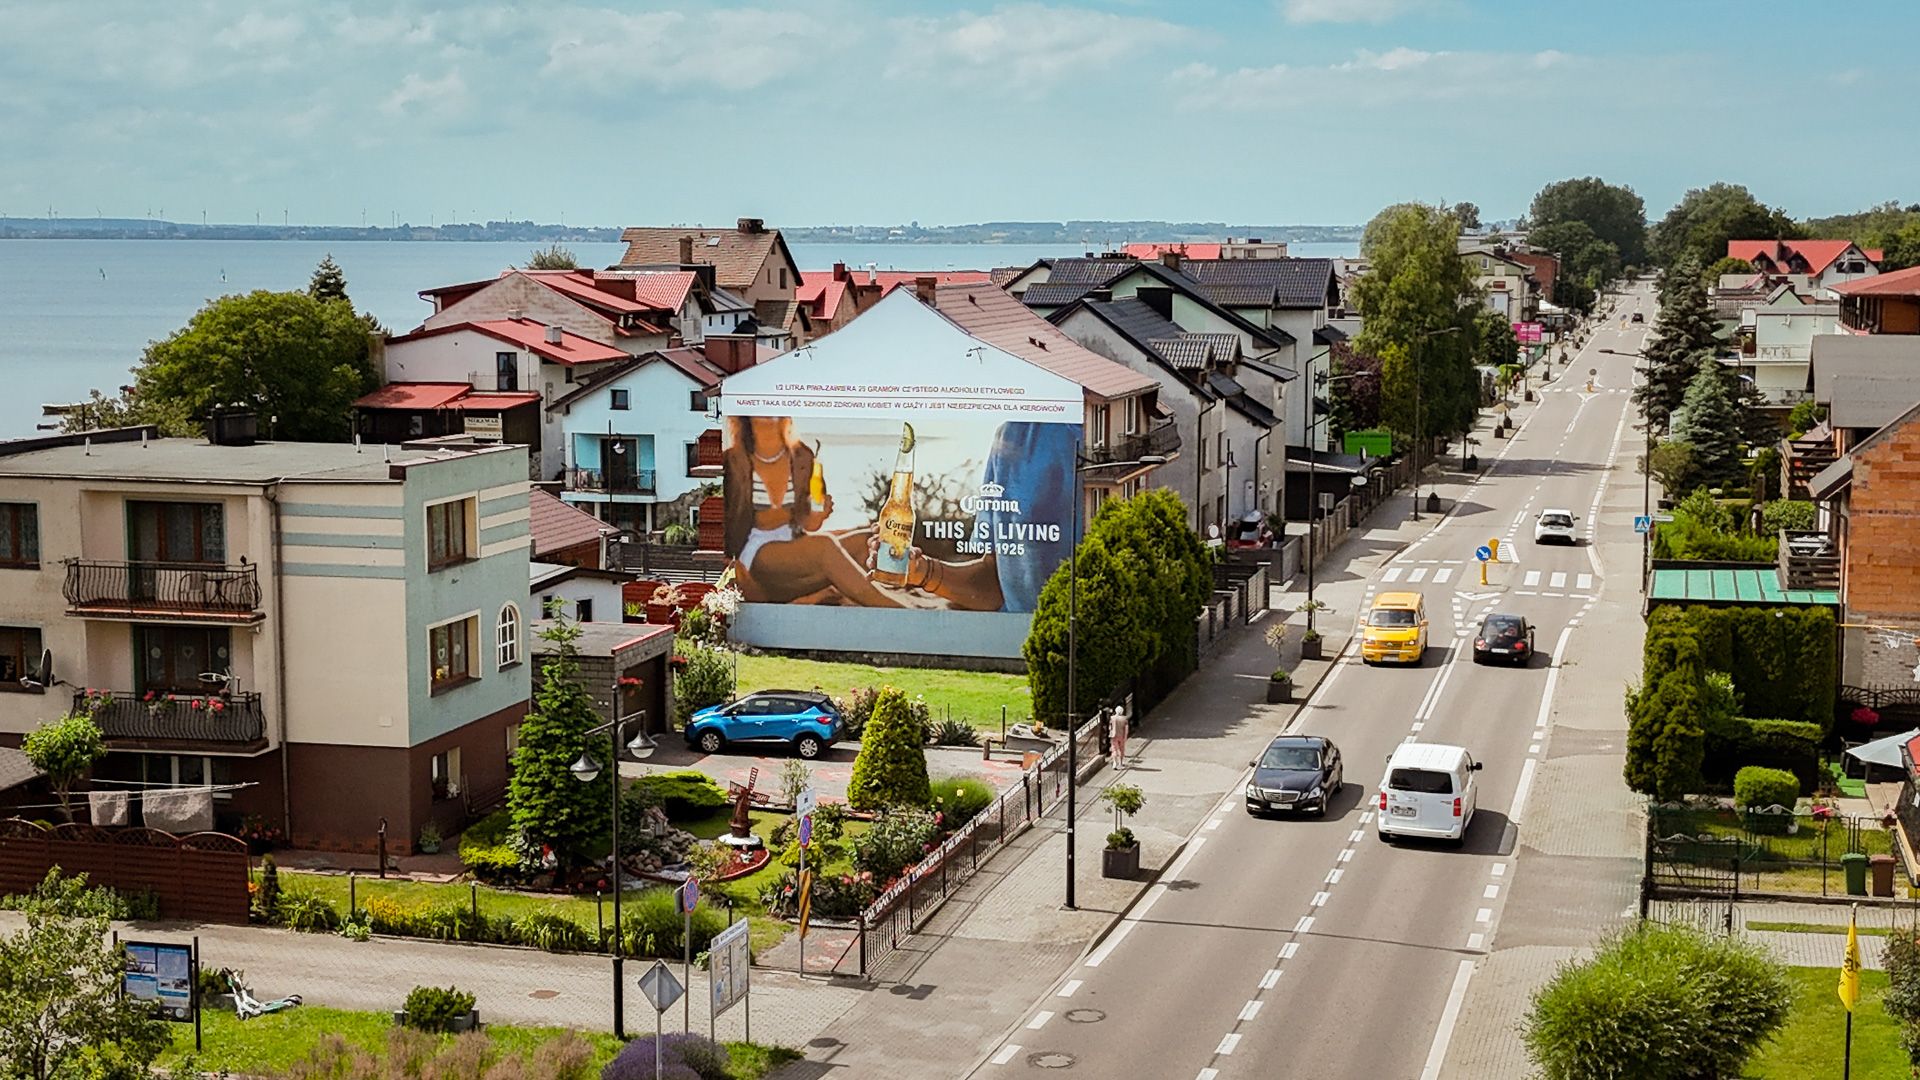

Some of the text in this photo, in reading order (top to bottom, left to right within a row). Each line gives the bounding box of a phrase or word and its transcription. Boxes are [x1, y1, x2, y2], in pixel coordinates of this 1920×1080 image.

[941, 386, 979, 394] ALKOHOLU
[980, 387, 1025, 395] ETYLOWEGO
[762, 399, 780, 407] TAKA
[833, 401, 866, 409] ZDROWIU
[867, 401, 892, 409] KOBIET
[947, 403, 1002, 411] NIEBEZPIECZNA
[1019, 405, 1066, 413] KIEROWCÓW
[960, 495, 1021, 515] Corona
[922, 521, 965, 539] THIS
[974, 522, 990, 540] IS
[998, 523, 1060, 542] LIVING
[956, 541, 1025, 555] SINCE 1925
